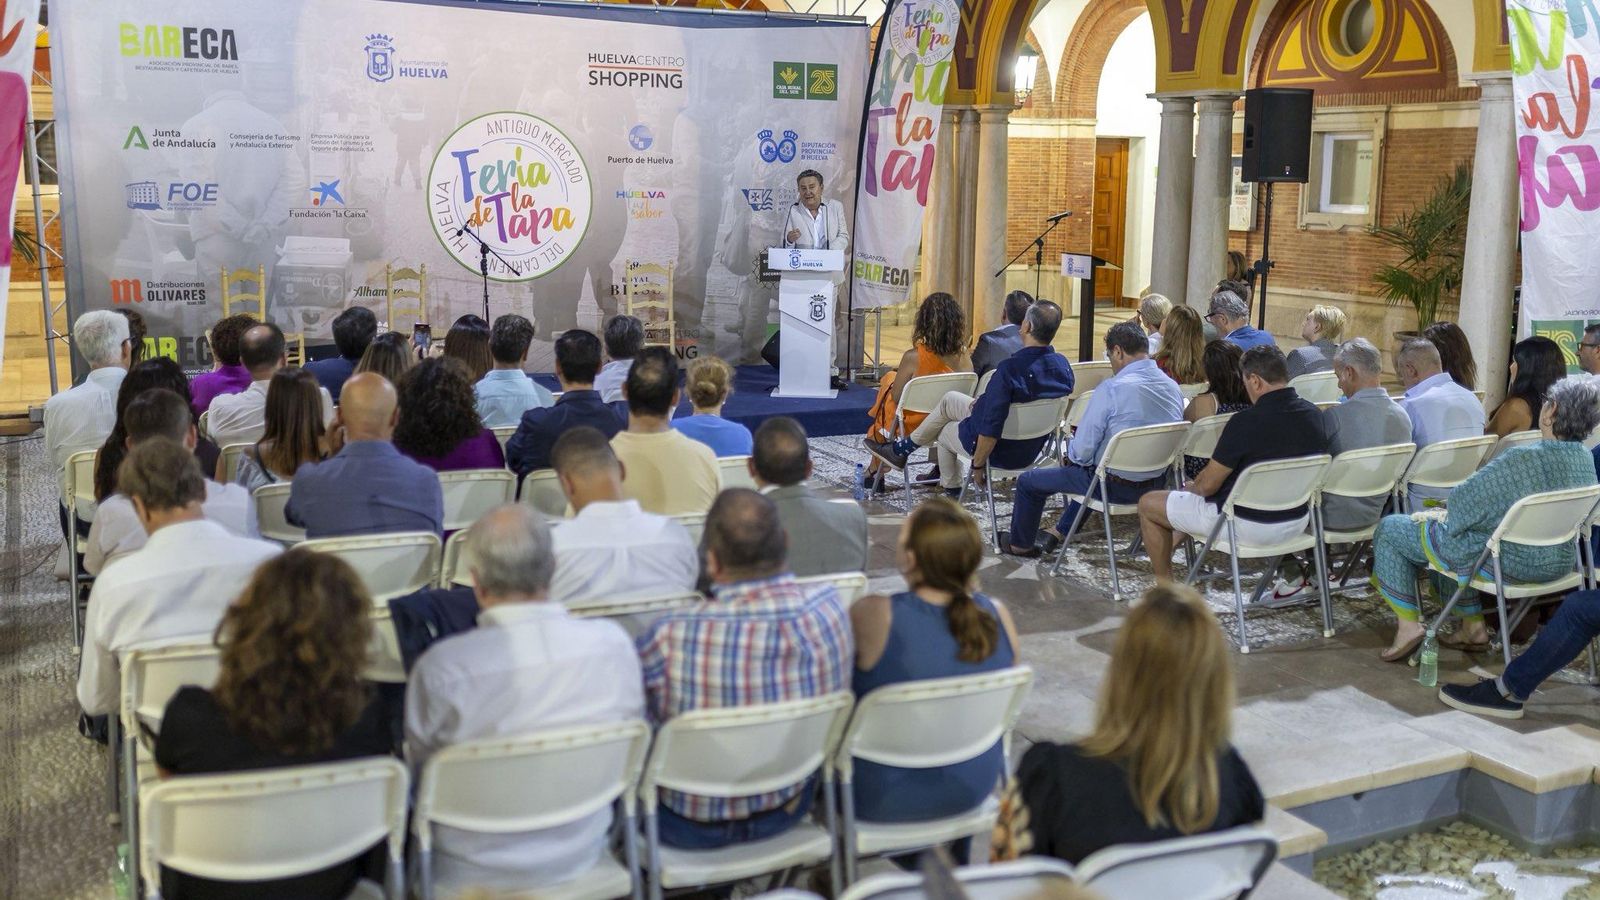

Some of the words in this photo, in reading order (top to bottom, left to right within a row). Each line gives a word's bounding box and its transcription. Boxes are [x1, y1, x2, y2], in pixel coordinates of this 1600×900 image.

[119, 22, 239, 61] BARECA
[914, 24, 950, 51] Tpa
[588, 53, 685, 67] HUELVACENTRO
[399, 67, 448, 78] HUELVA
[588, 70, 683, 89] SHOPPING
[486, 119, 540, 138] ANTIGUO
[896, 92, 936, 146] la
[152, 129, 181, 138] Junta
[152, 139, 165, 148] de
[167, 139, 216, 149] Andalucía
[541, 131, 583, 184] MERCADO
[607, 156, 634, 164] Puerto
[635, 156, 646, 164] de
[647, 156, 674, 165] Huelva
[451, 146, 551, 204] Feria
[168, 183, 219, 202] FOE
[289, 208, 331, 218] Fundación
[469, 195, 494, 228] de
[511, 182, 536, 212] la
[436, 181, 468, 253] HUELVA
[483, 192, 576, 245] Tapa
[544, 242, 564, 263] DEL
[487, 257, 540, 274] CARMEN
[855, 260, 910, 287] BARECA
[146, 281, 205, 289] Distribuciones
[147, 289, 206, 301] OLIVARES
